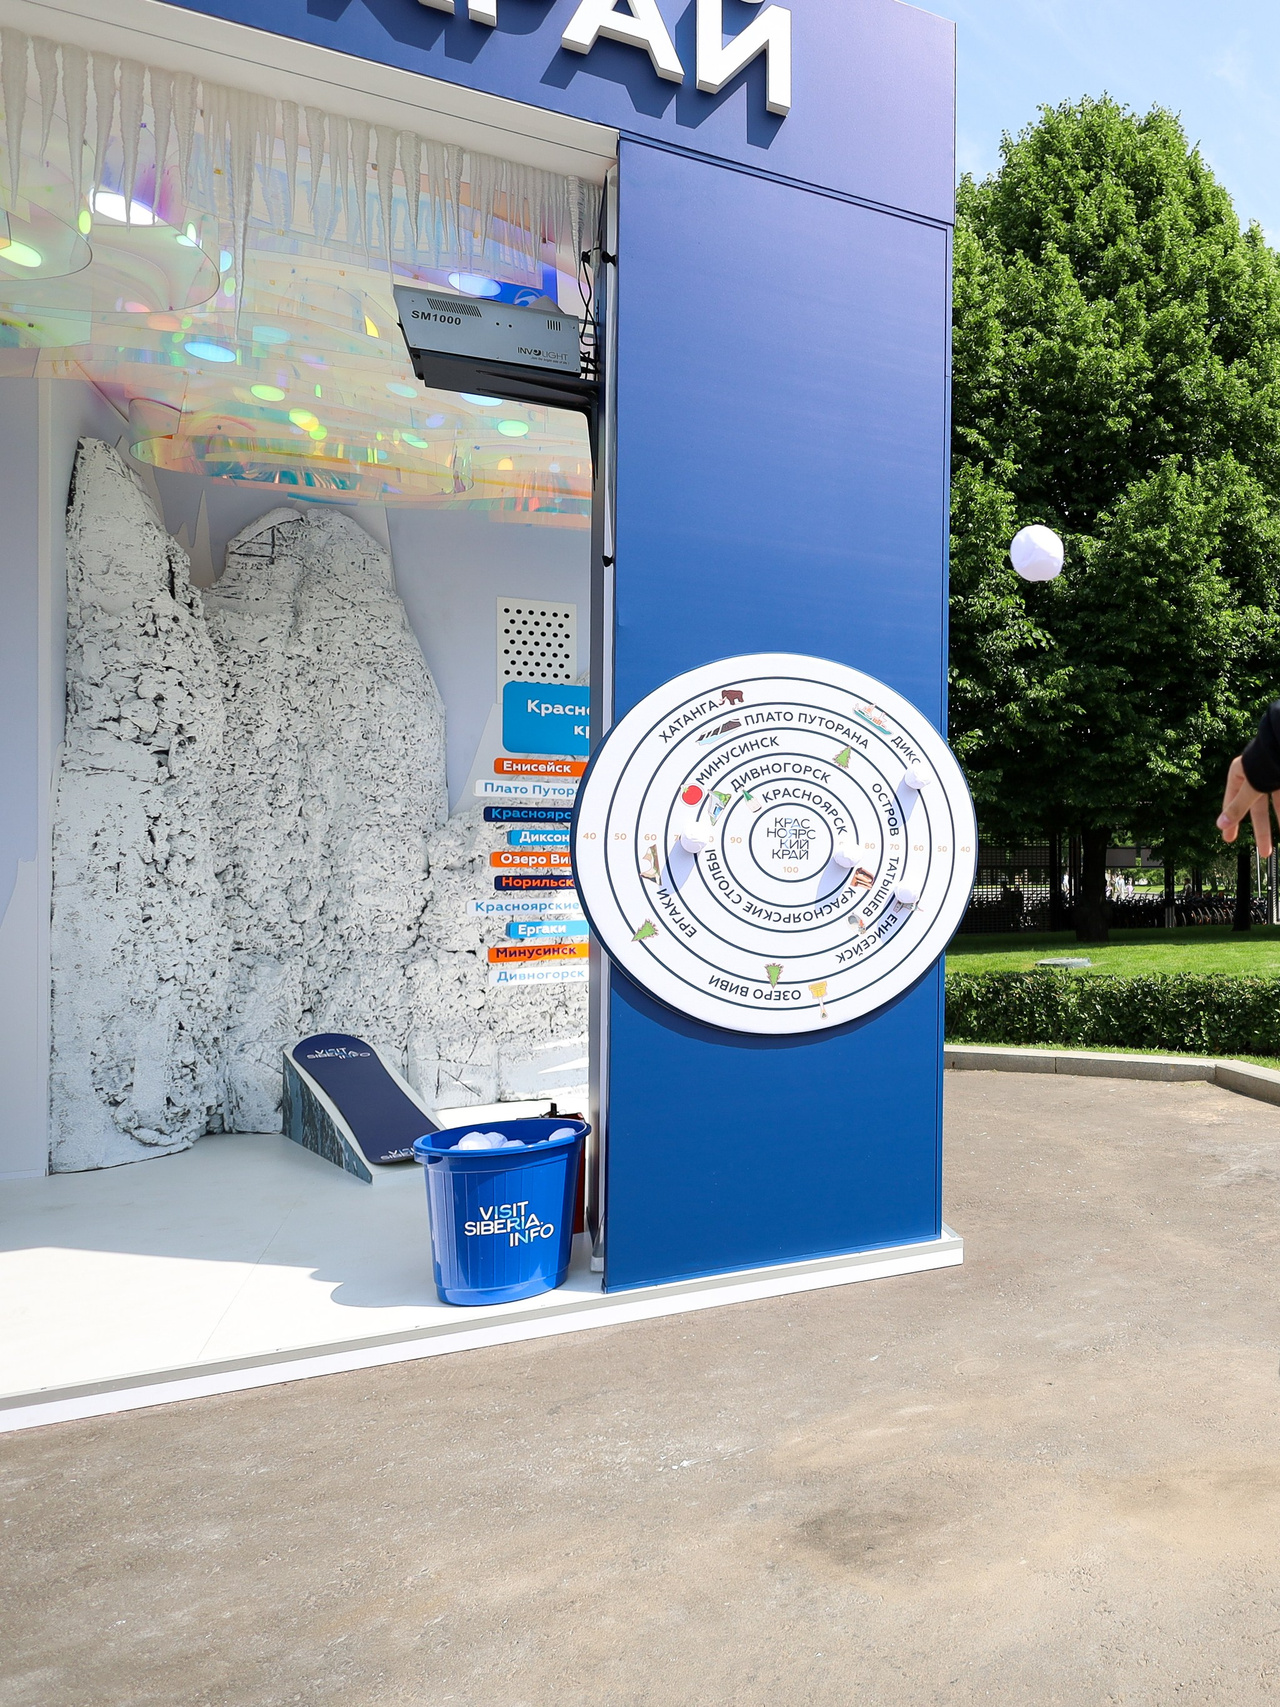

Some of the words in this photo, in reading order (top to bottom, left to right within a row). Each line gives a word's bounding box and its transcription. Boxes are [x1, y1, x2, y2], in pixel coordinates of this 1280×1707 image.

[418, 0, 792, 117] АЙ
[411, 310, 462, 326] SM1000
[517, 346, 568, 361] INVOLIGHT
[658, 700, 719, 743] ХАТАНГА
[744, 711, 793, 726] ПЛАТО
[798, 712, 869, 749] ПУТОРАНА
[503, 760, 572, 774] Енисейск
[695, 736, 780, 785] МИНУСИНСК
[730, 762, 831, 793] ДИВНОГОРСК
[484, 782, 528, 794] Плато
[532, 785, 577, 797] Путор
[491, 808, 572, 821] Красноярс
[762, 787, 848, 835] КРАСНОЯРСК
[872, 783, 900, 836] ОСТРОВ
[775, 817, 811, 829] КРАС
[519, 831, 570, 844] Диксон
[583, 832, 597, 840] 40
[614, 833, 627, 841] 50
[644, 833, 657, 841] 60
[730, 836, 743, 844] 90
[766, 827, 816, 840] НОЯРС
[780, 838, 809, 849] КИЙ
[864, 842, 876, 850] 80
[889, 843, 900, 851] 70
[913, 844, 924, 852] 60
[937, 845, 948, 853] 50
[960, 845, 971, 853] 40
[500, 853, 547, 866] Озеро
[550, 854, 572, 864] Ви
[772, 849, 809, 860] КРАЙ
[704, 849, 743, 905] СТОЛБЫ
[783, 866, 799, 874] 100
[501, 877, 575, 889] Норильск
[862, 857, 899, 917] ТАТЫШЕВ
[475, 901, 579, 913] Красноярские
[742, 887, 857, 923] КРАСНОЯРСКИЕ
[656, 888, 698, 938] ЕРГАКИ
[518, 924, 567, 937] Ергаки
[835, 913, 898, 964] ЕНИСЕЙСК
[496, 946, 577, 959] Минусинск
[497, 969, 585, 983] Дивногорск
[708, 975, 750, 997] ВИВИ
[753, 989, 802, 1001] ОЗЕРО
[479, 1200, 529, 1220] VISIT
[464, 1213, 544, 1236] SIBERIA.
[509, 1223, 554, 1247] INFO
